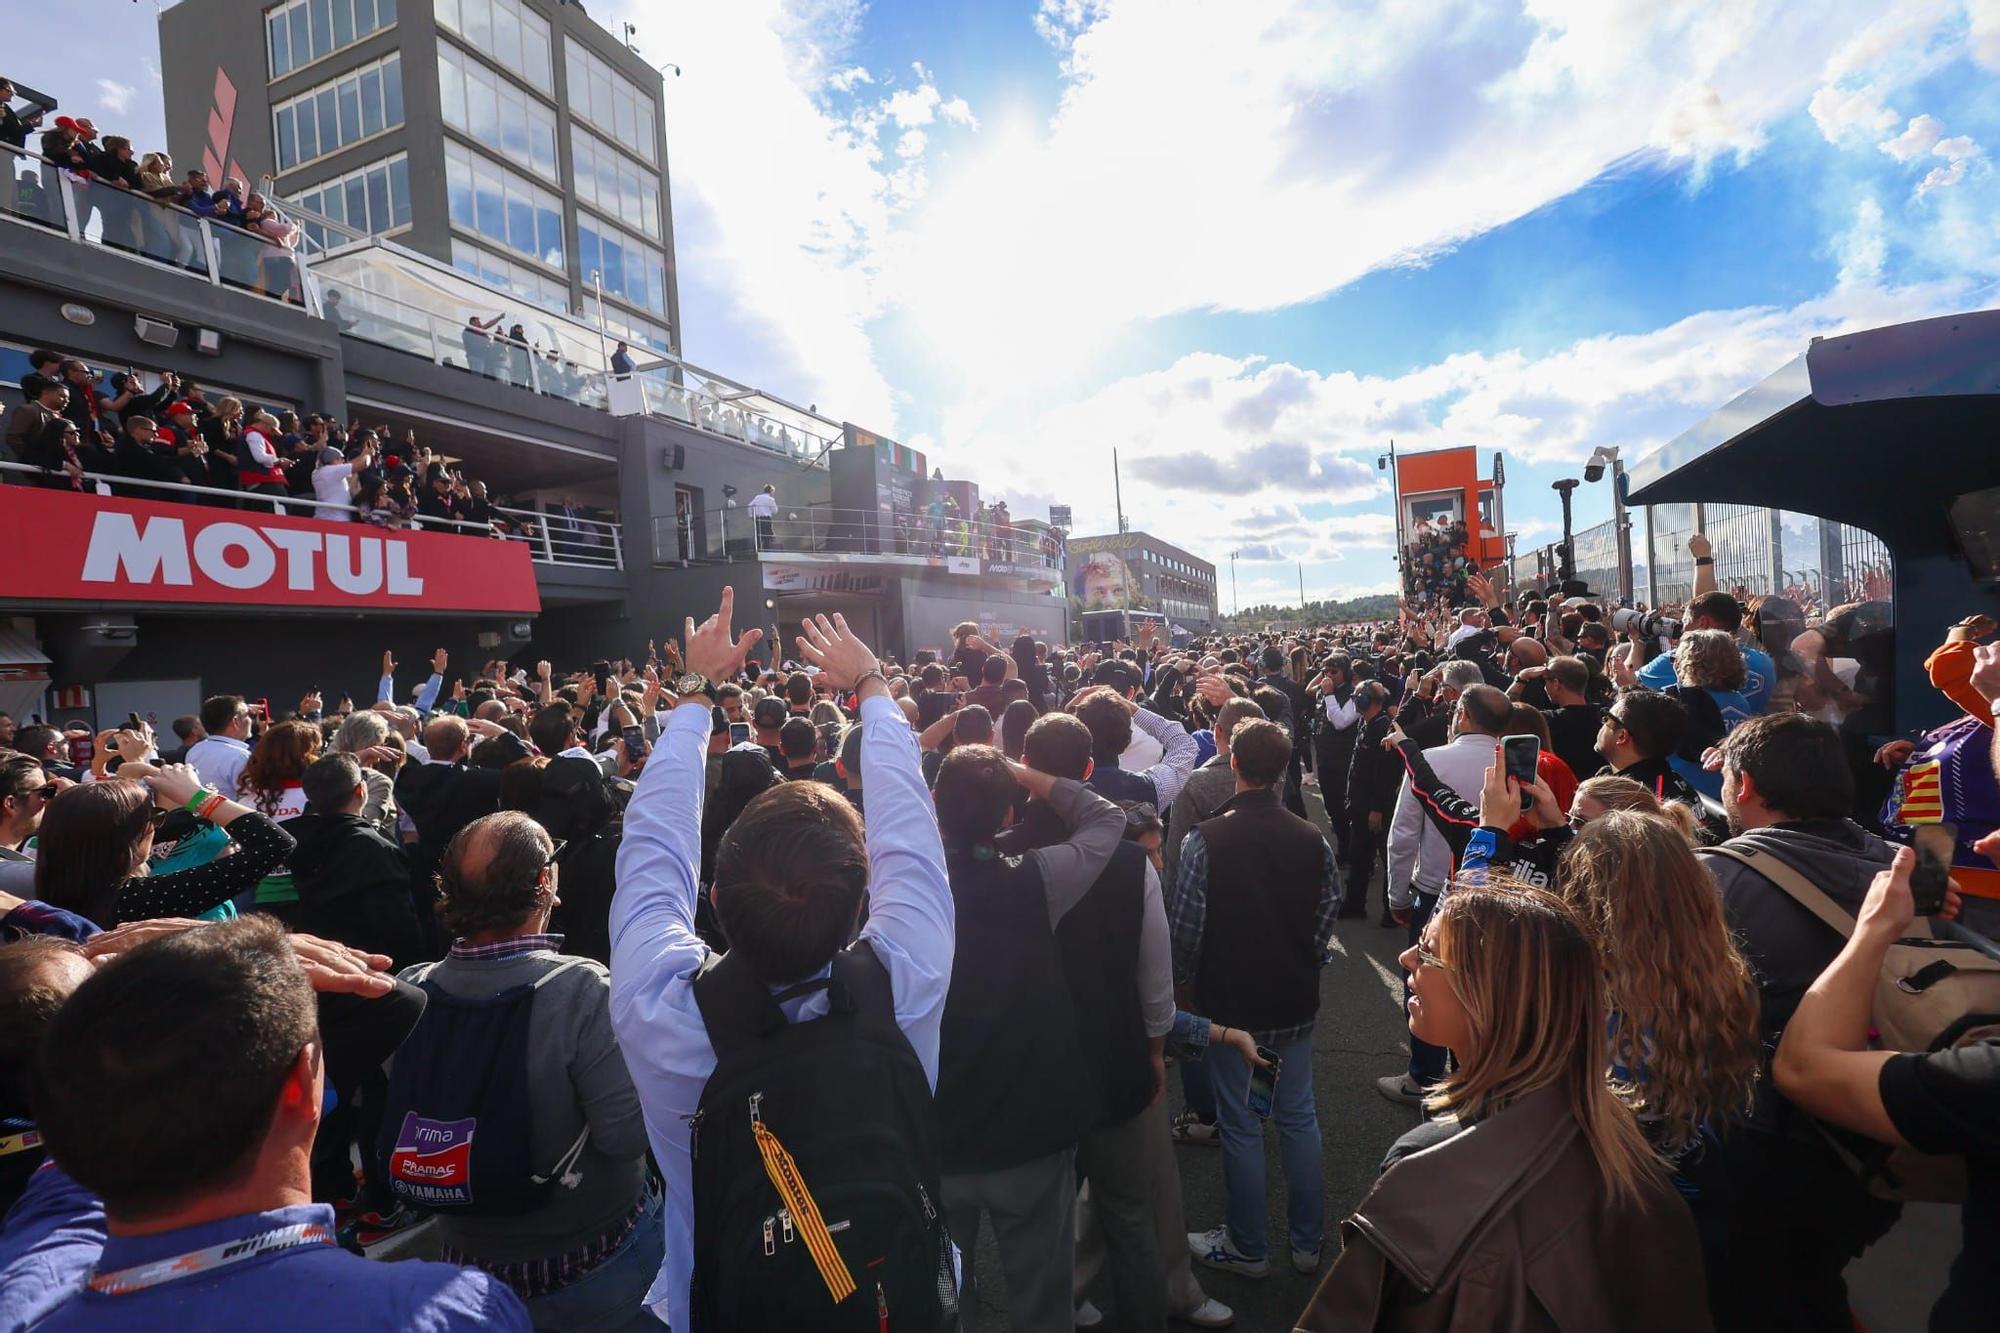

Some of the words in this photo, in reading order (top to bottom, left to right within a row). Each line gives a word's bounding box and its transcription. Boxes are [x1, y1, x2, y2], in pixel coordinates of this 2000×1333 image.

[80, 511, 424, 596] MOTUL
[403, 1160, 456, 1174] PRAMAC
[408, 1184, 464, 1199] YAMAHA
